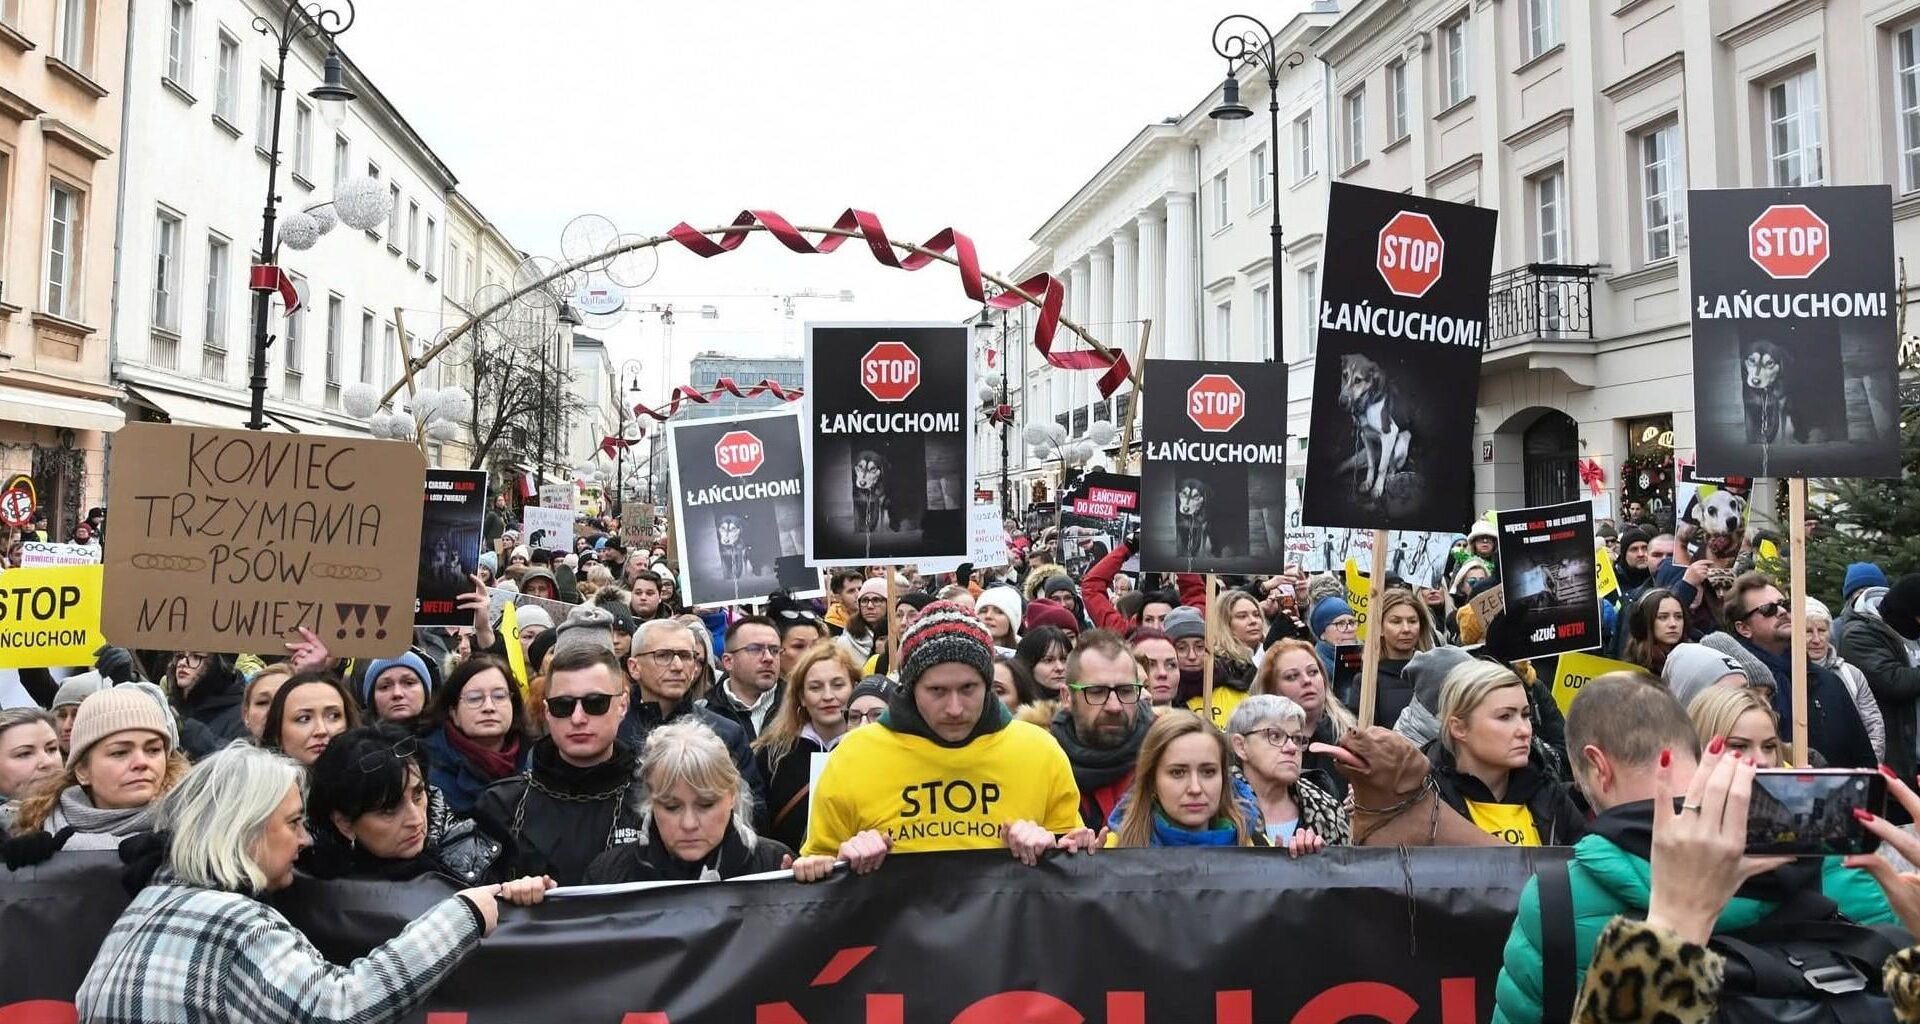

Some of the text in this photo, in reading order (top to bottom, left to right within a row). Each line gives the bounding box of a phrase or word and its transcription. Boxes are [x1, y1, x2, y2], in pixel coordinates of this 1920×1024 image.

[1383, 233, 1438, 274] STOP
[1755, 228, 1823, 257] STOP
[1697, 290, 1888, 319] ŁAŃCUCHOM!
[1320, 299, 1483, 348] ŁAŃCUCHOM!
[866, 359, 917, 384] STOP
[1191, 391, 1241, 415] STOP
[819, 409, 960, 434] ŁAŃCUCHOM!
[187, 432, 357, 492] KONIEC
[719, 443, 761, 466] STOP
[1146, 439, 1283, 465] ŁAŃCUCHOM!
[686, 478, 801, 507] ŁAŃCUCHOM!
[1091, 488, 1133, 506] ŁAŃCUCHY
[134, 492, 382, 547] TRZYMANIA
[1077, 503, 1113, 515] DO KOSZA
[208, 539, 312, 585] PSÓW
[1348, 590, 1369, 608] ZUĆ
[136, 596, 392, 641] NA UWIĘZI !!!
[1530, 622, 1585, 642] RZUĆ WETO!
[0, 627, 86, 648] ŃCUCHOM
[900, 780, 1000, 817] STOP
